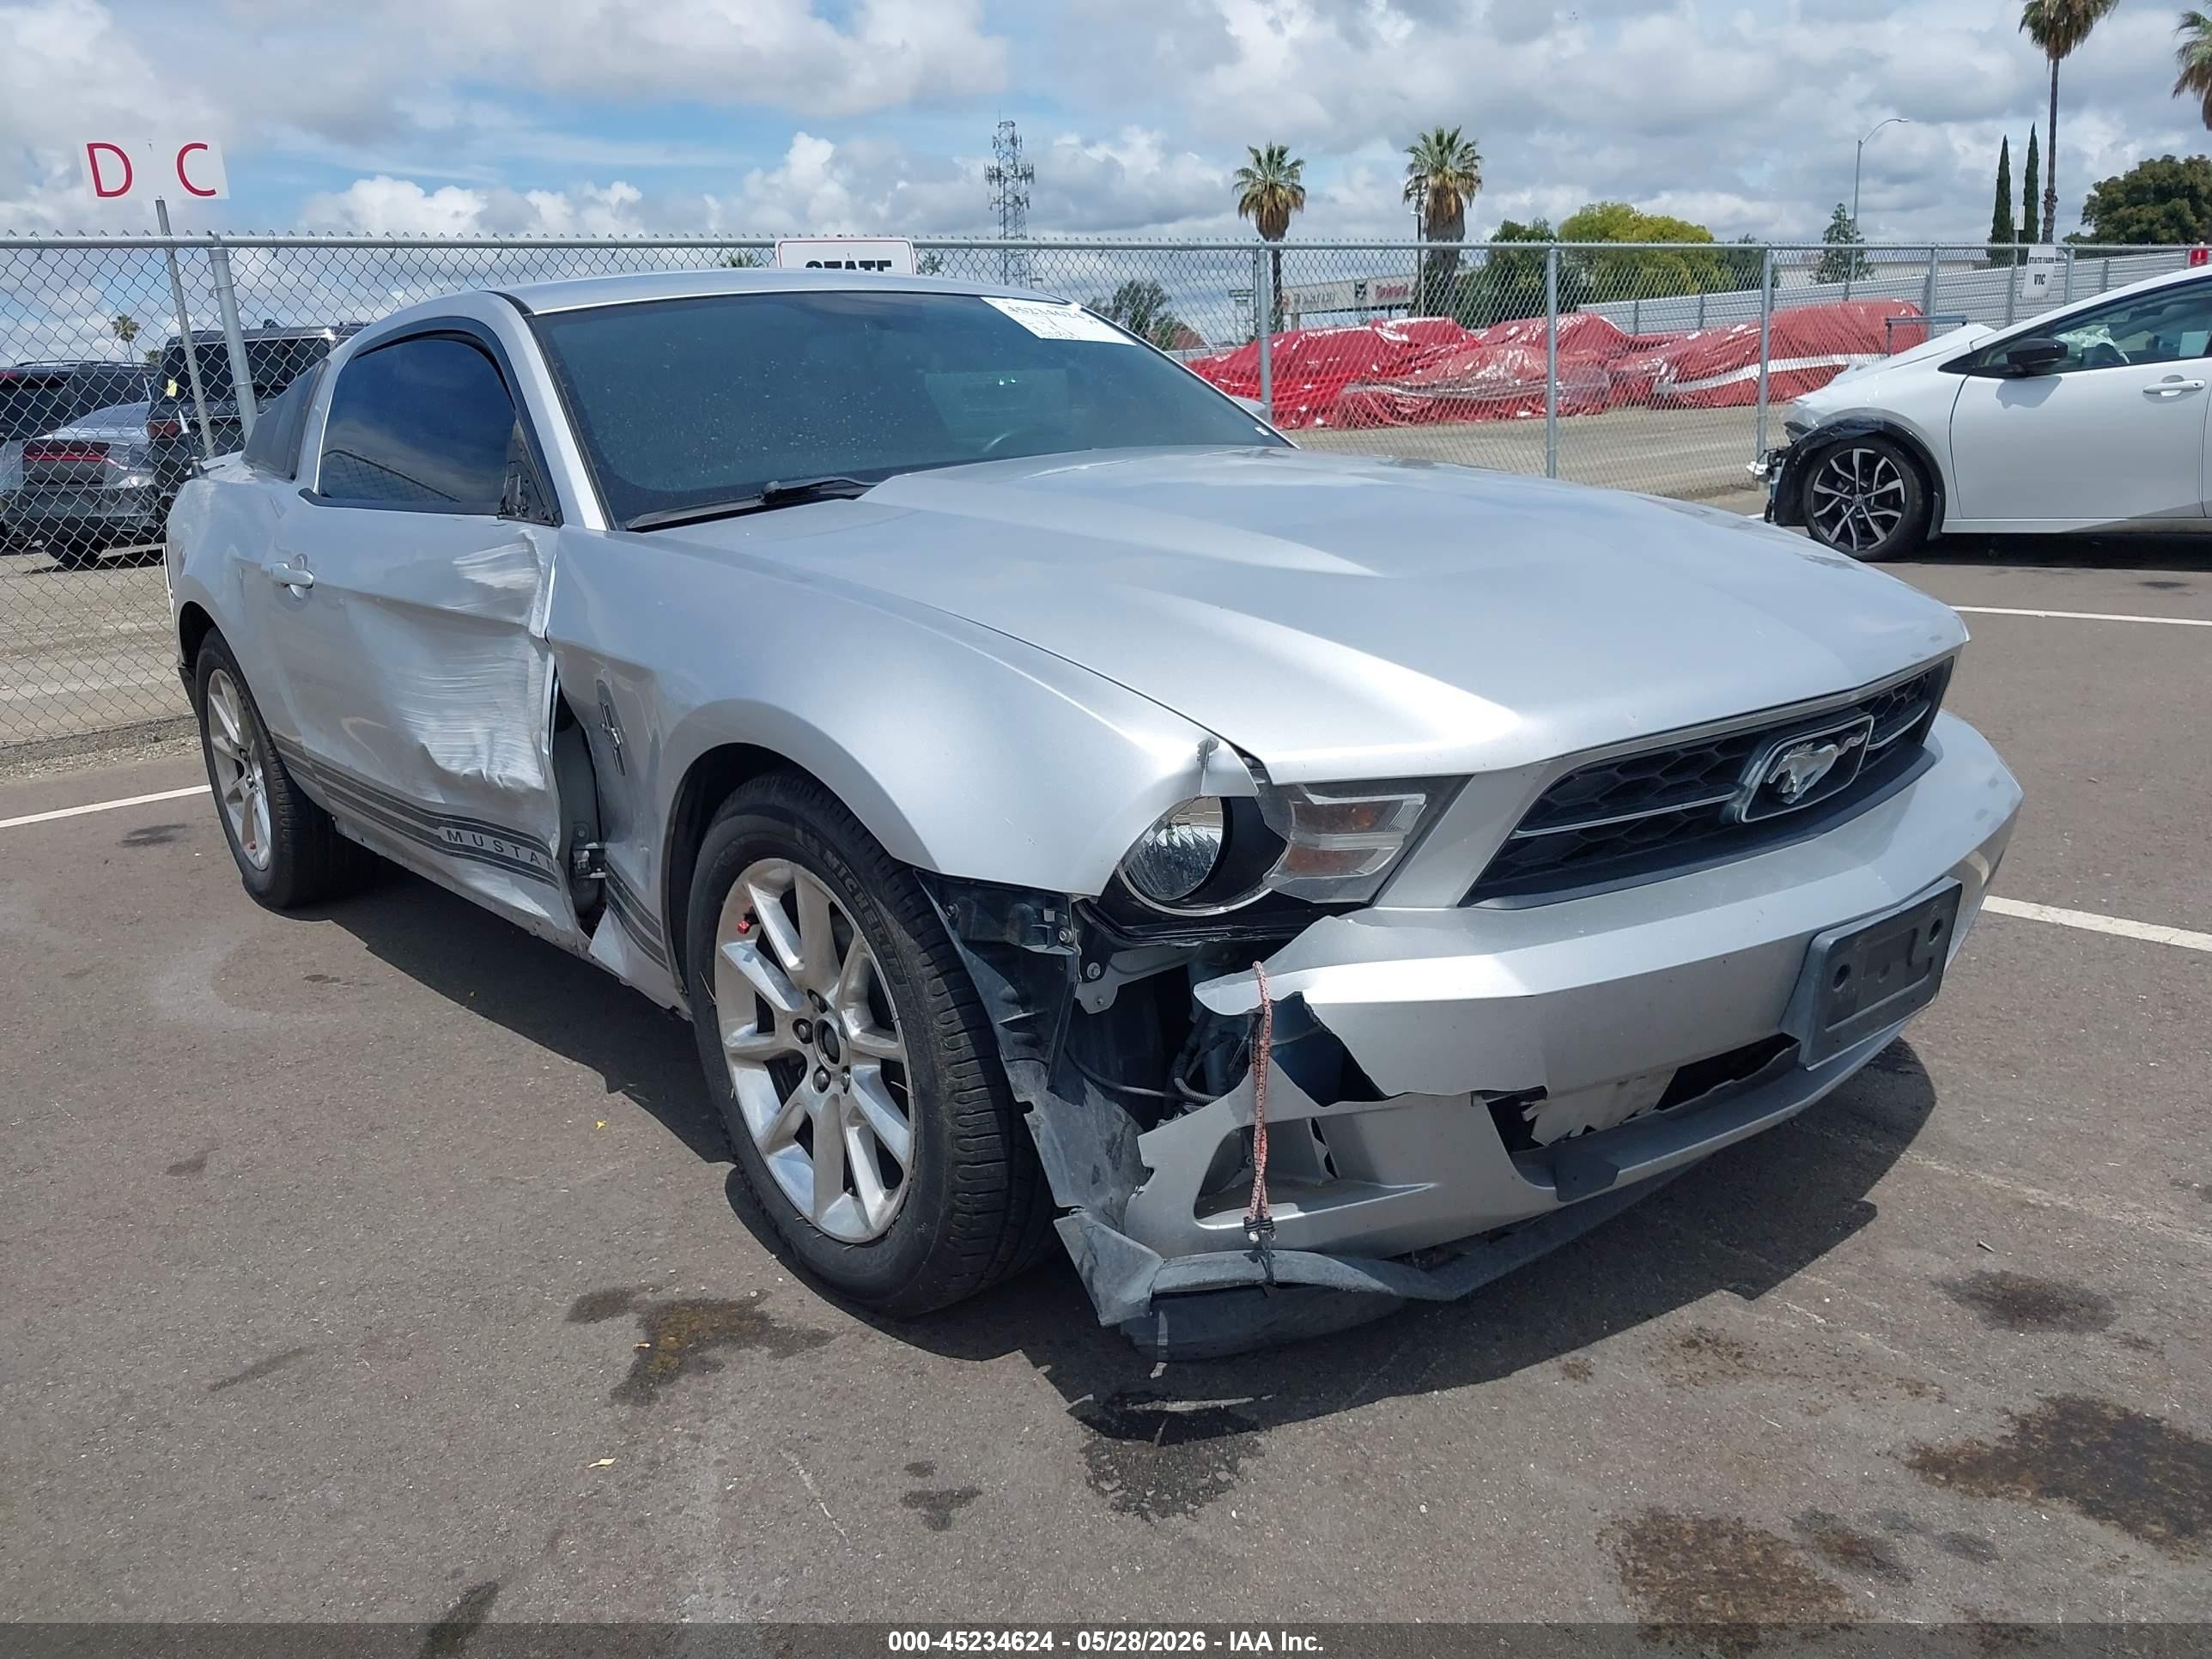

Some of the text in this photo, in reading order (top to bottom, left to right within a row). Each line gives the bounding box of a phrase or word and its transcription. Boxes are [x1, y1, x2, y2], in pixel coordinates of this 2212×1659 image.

[86, 142, 217, 198] D C
[2033, 273, 2046, 285] VIC
